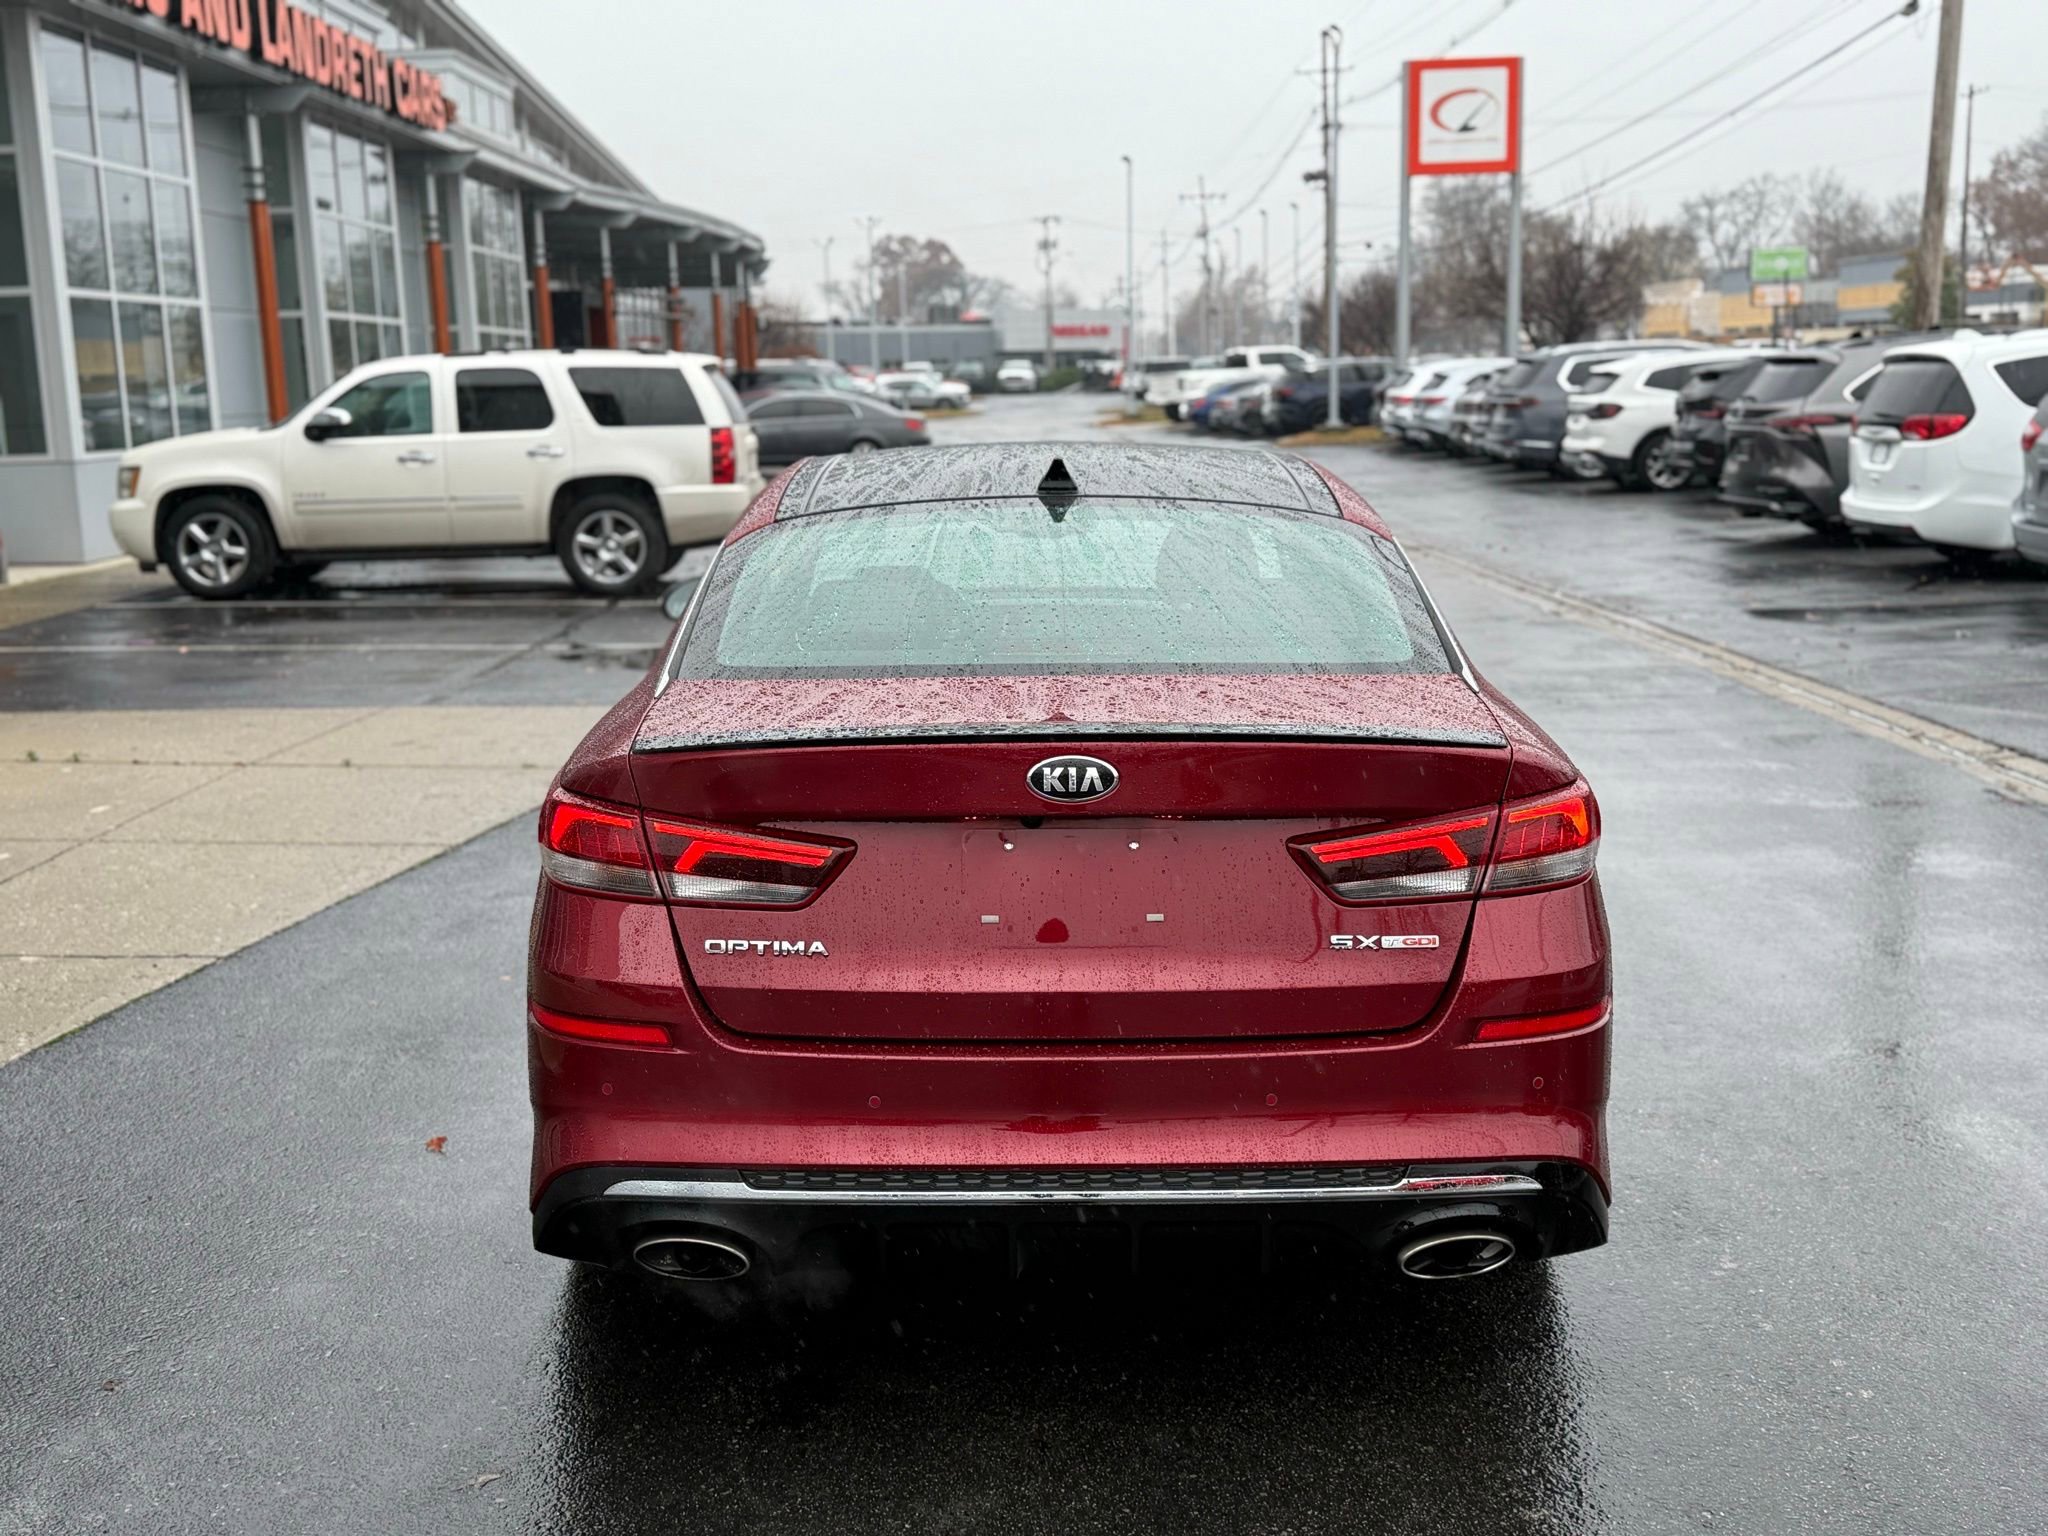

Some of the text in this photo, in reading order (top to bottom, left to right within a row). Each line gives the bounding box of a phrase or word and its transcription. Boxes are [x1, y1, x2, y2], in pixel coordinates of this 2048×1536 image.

[257, 0, 391, 112] LANDRETH
[393, 57, 448, 132] CARS
[1042, 766, 1104, 792] KIA
[704, 939, 829, 956] OPTIMA
[1330, 934, 1380, 950] SX
